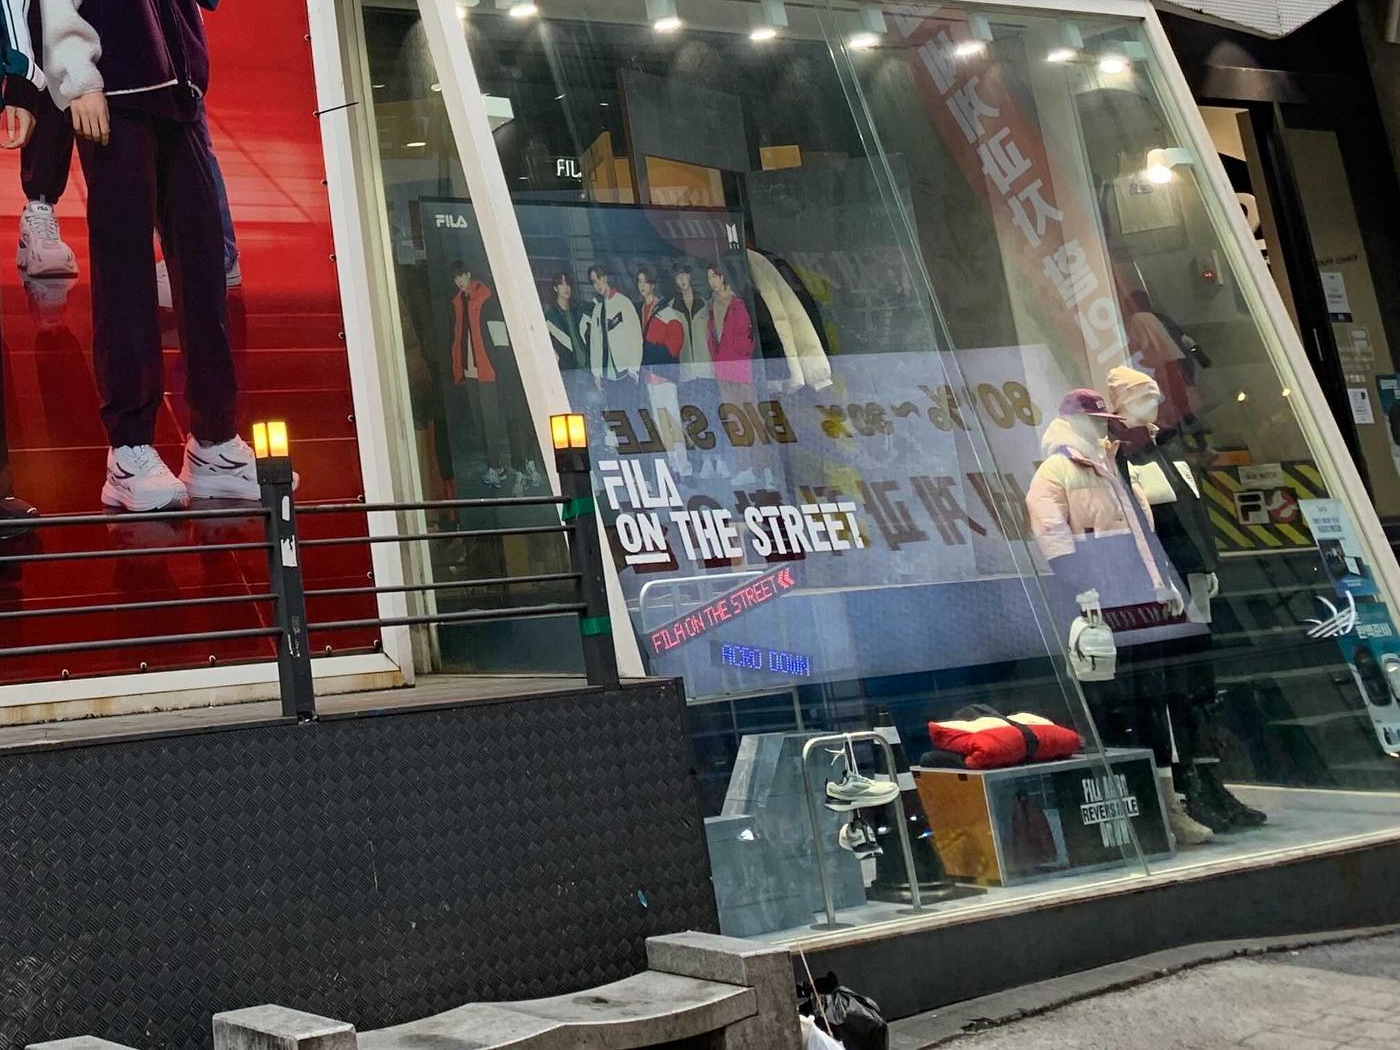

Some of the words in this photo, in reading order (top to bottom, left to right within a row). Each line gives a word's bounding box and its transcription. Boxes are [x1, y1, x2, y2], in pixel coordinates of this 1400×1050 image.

[557, 158, 582, 178] FIL
[435, 214, 468, 228] FILA
[598, 458, 684, 510] FILA
[616, 512, 668, 555] ON
[669, 508, 744, 561] THE
[743, 501, 865, 557] STREET
[651, 623, 688, 654] FILA
[703, 599, 732, 627] THE
[729, 574, 779, 614] STREET
[768, 650, 811, 677] DOWN
